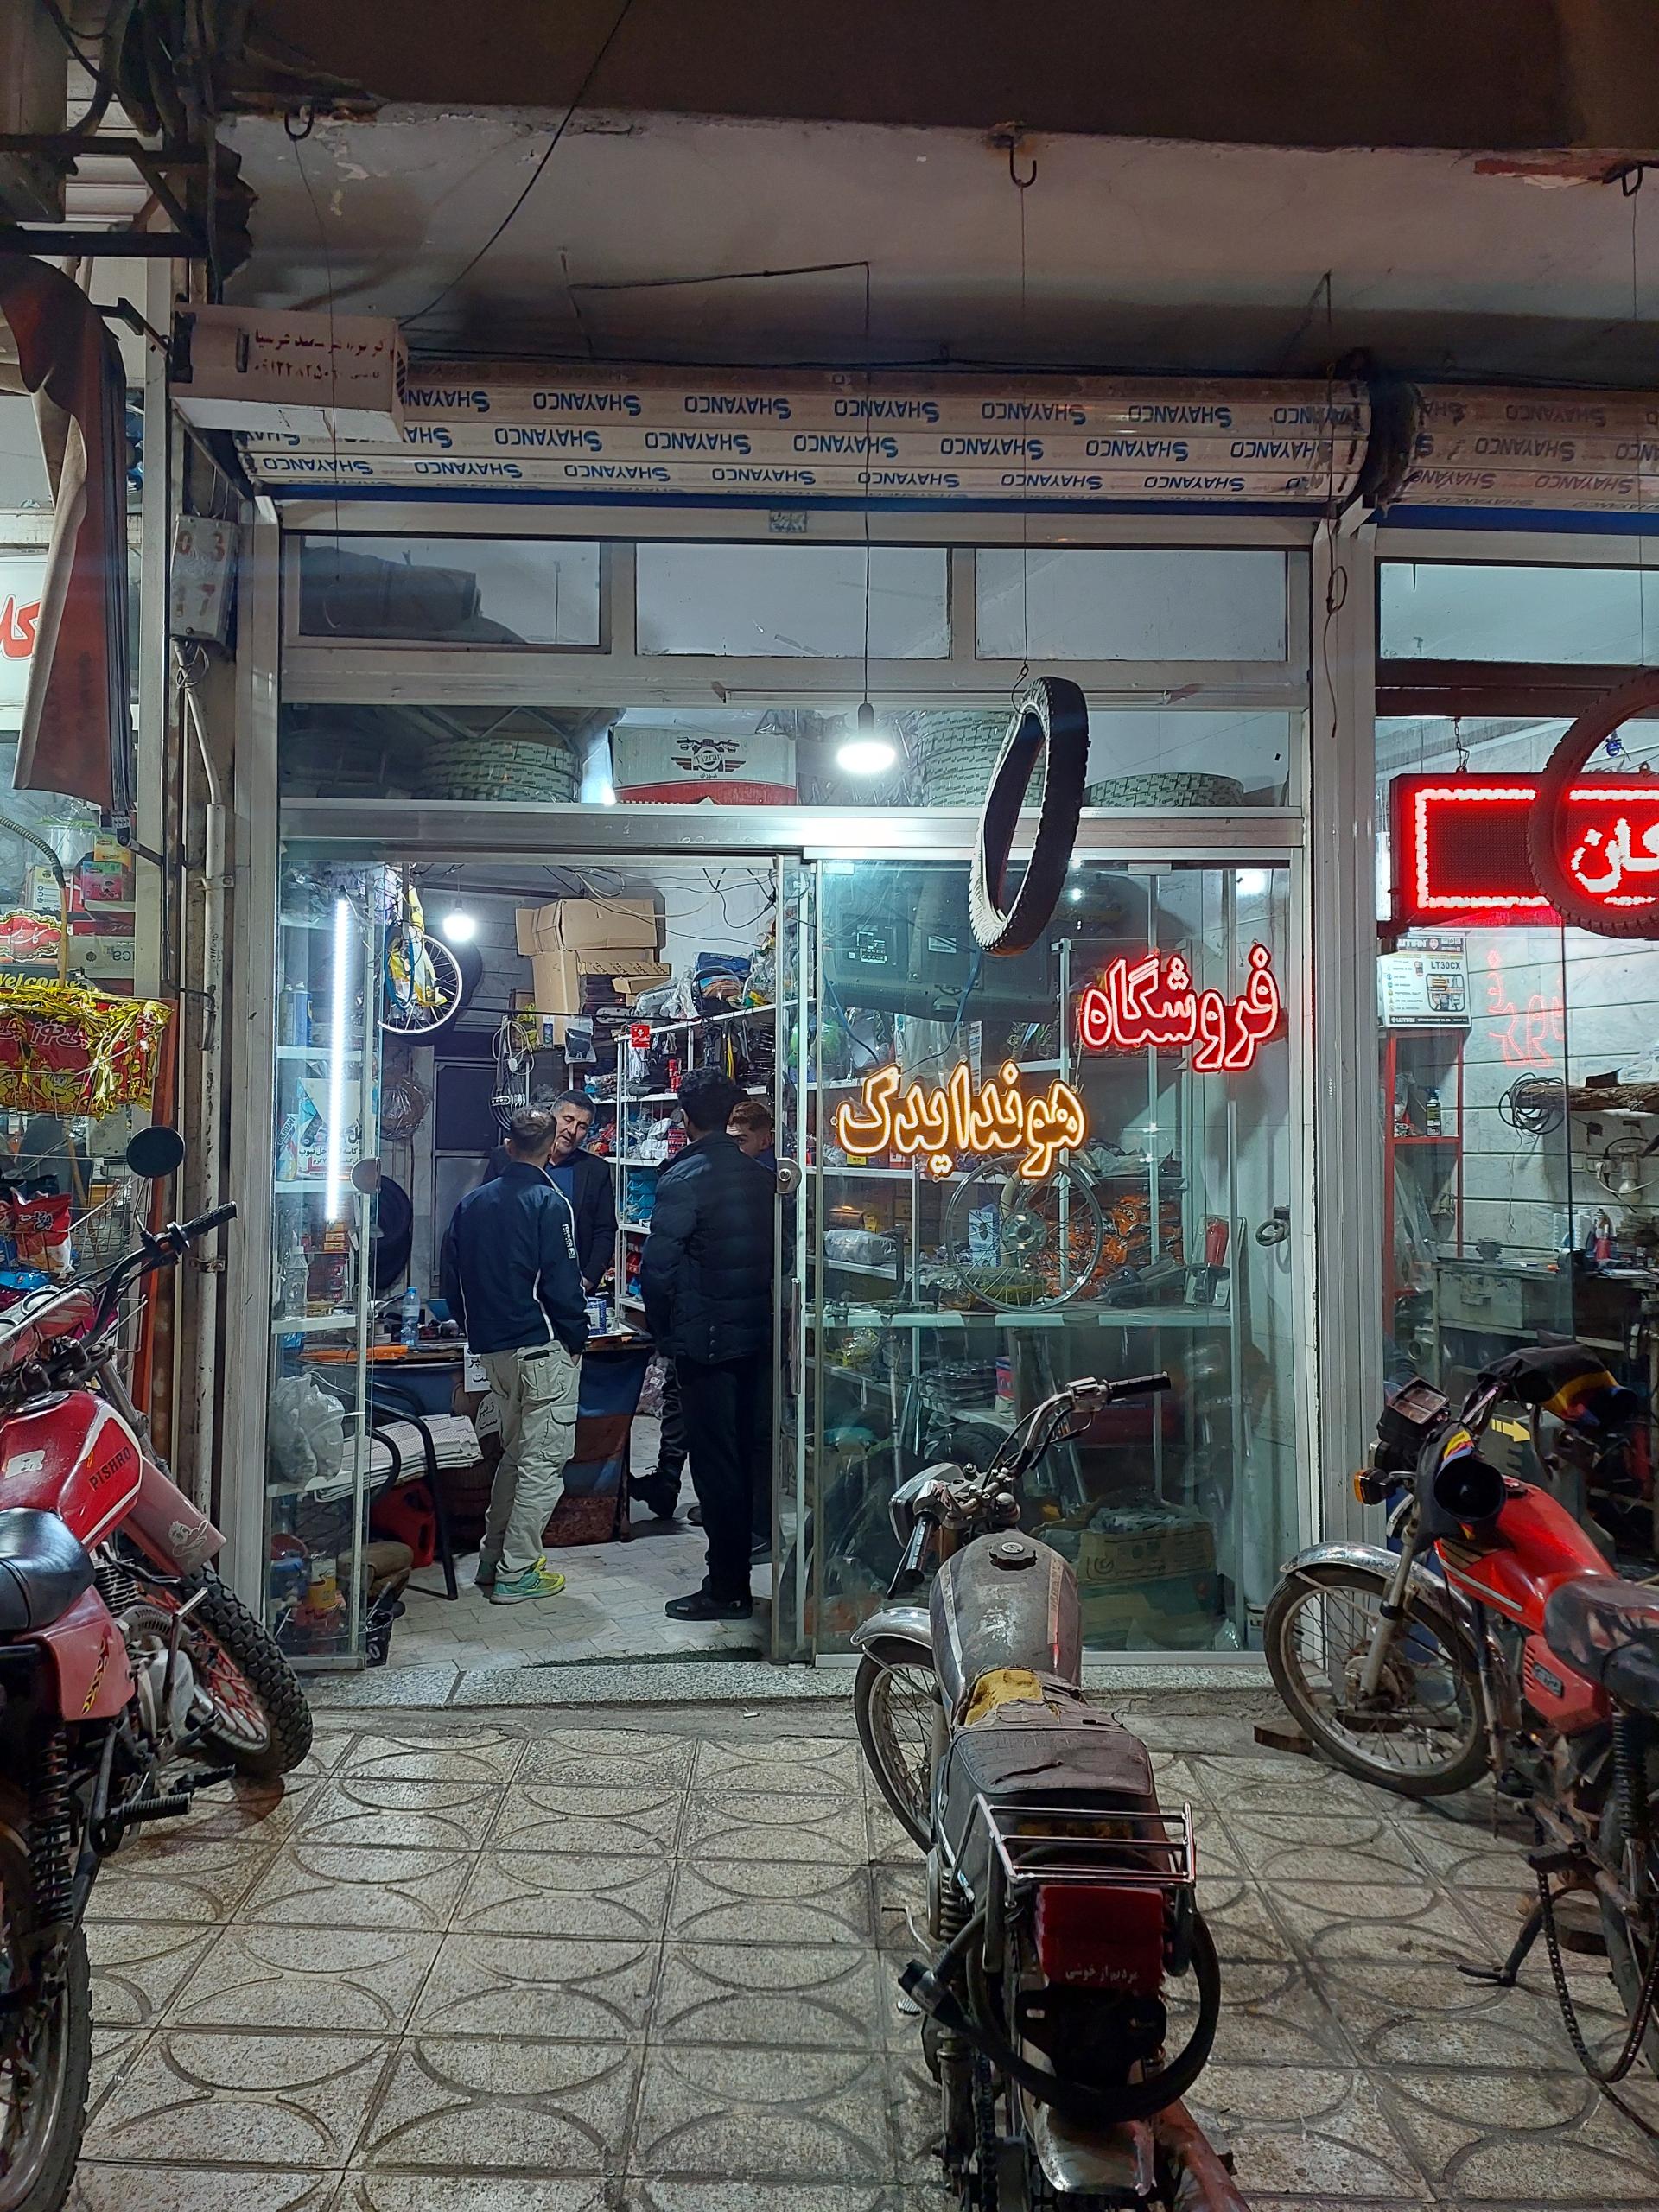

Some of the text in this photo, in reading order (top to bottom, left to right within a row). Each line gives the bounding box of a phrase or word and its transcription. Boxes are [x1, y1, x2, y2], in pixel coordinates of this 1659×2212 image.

[404, 390, 490, 413] SHAYAN
[533, 391, 642, 416] SHAYANCO
[684, 396, 791, 420] SHAYANCO
[834, 398, 940, 423] SHAYANCO
[982, 402, 1086, 425] SHAYANCO
[1128, 405, 1233, 429] SHAYANCO
[494, 428, 602, 452] SHAYANCO
[645, 431, 751, 455] SHAYANCO
[793, 435, 899, 458] SHAYANCO
[940, 438, 1044, 461] SHAYANCO
[1085, 440, 1189, 462] SHAYANCO
[1474, 437, 1575, 462] SHAYANCO
[263, 457, 1245, 492] SHAYANCO SHAYANCO SHAYANCO SHAYANCO SHAYANCO SHAYANCO SHAYANCO
[1535, 475, 1634, 495] SHAYANCO
[694, 753, 723, 764] Tizran
[1430, 961, 1461, 970] LT30CX
[1083, 944, 1281, 1071] فروشگاه
[89, 1446, 131, 1491] PISHRO
